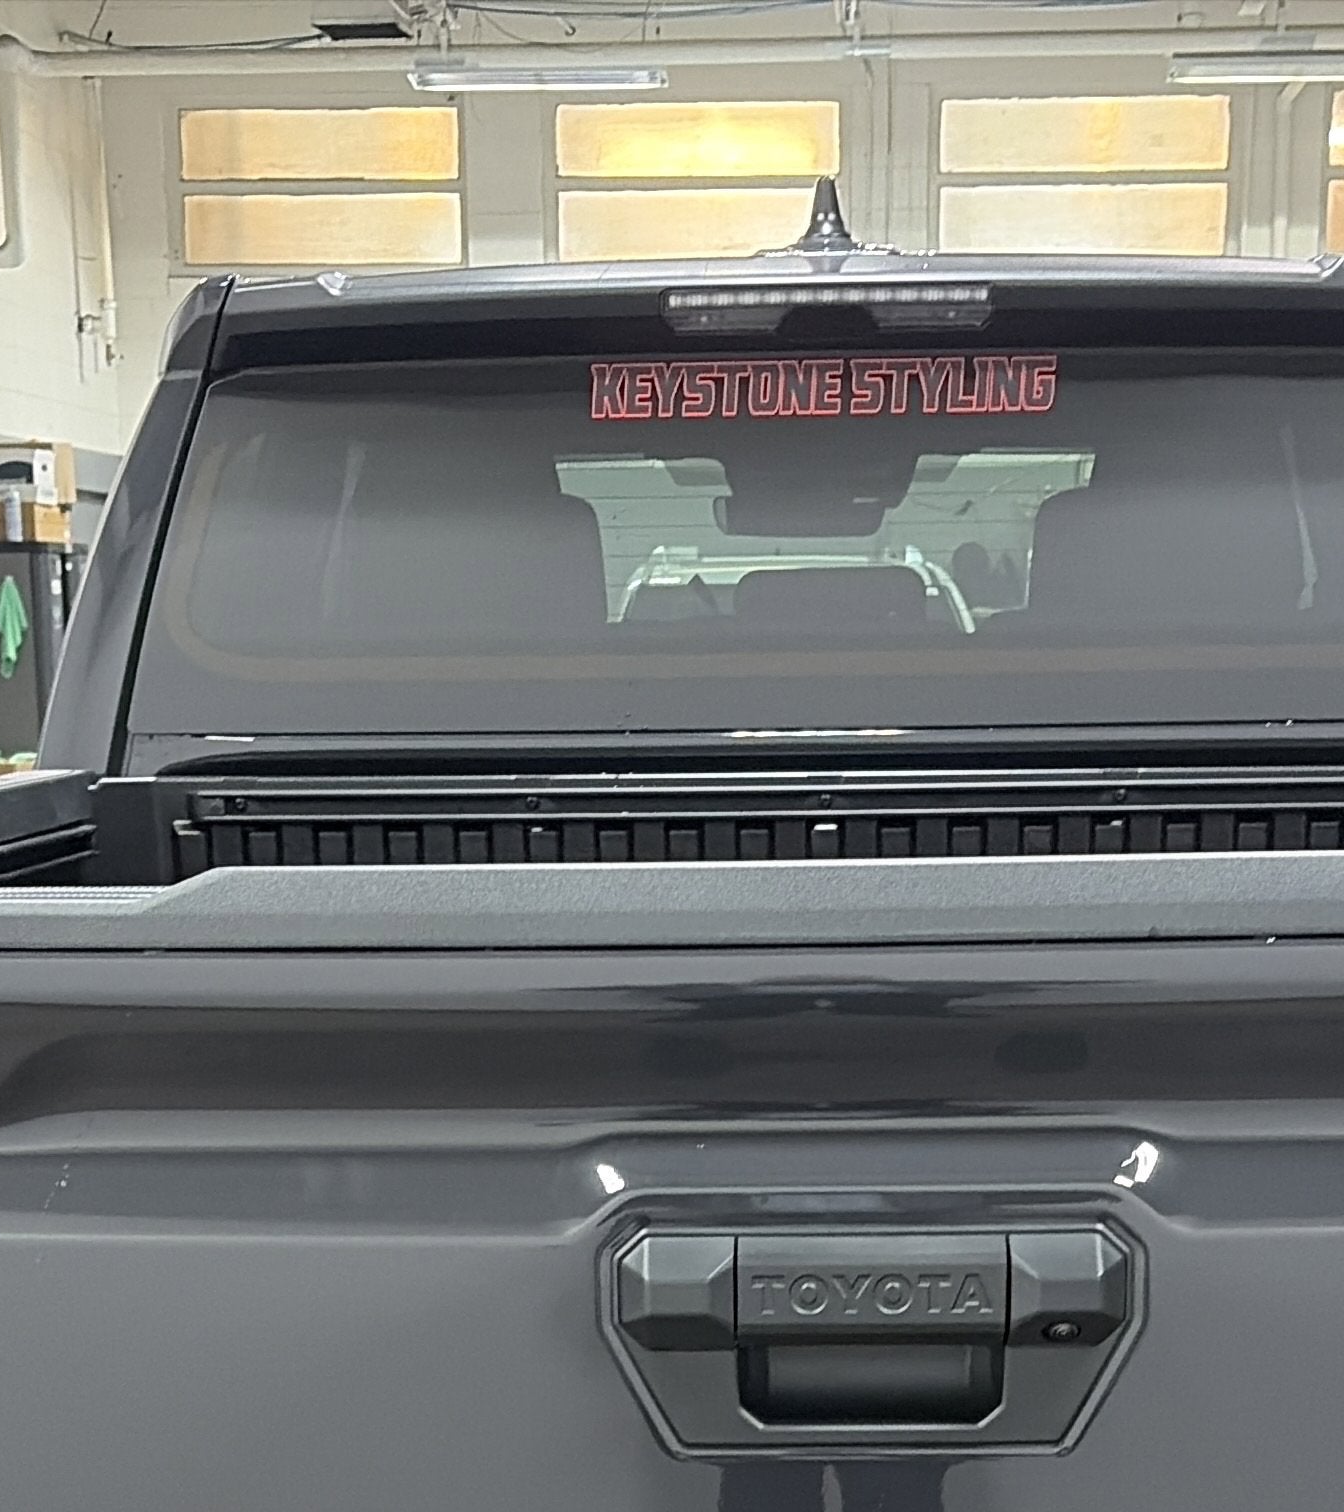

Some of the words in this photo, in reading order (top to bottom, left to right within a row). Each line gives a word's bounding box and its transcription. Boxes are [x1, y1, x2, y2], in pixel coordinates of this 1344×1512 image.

[590, 358, 844, 419] KEYSTONE
[849, 354, 1057, 416] STYLING
[751, 1272, 994, 1316] TOYOTA
